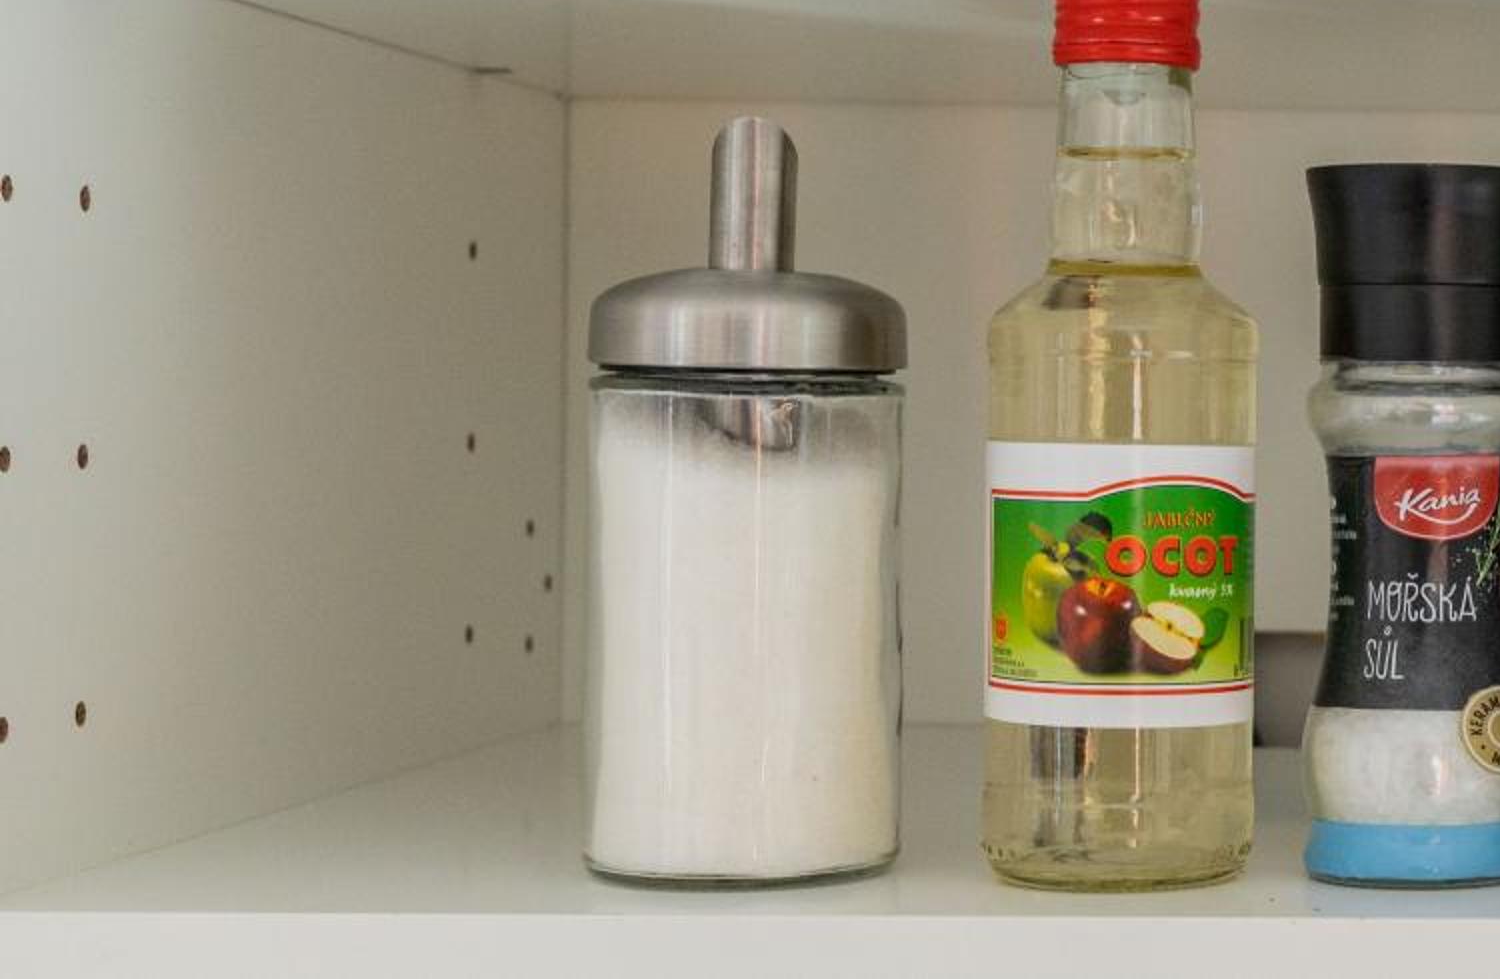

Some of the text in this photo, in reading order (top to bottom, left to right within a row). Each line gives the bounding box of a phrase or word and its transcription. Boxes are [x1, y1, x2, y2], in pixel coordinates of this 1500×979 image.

[1395, 488, 1481, 525] Kania
[1105, 536, 1238, 577] OCOT
[1366, 572, 1478, 622] MOŘSKÁ
[1362, 625, 1405, 681] SŮL
